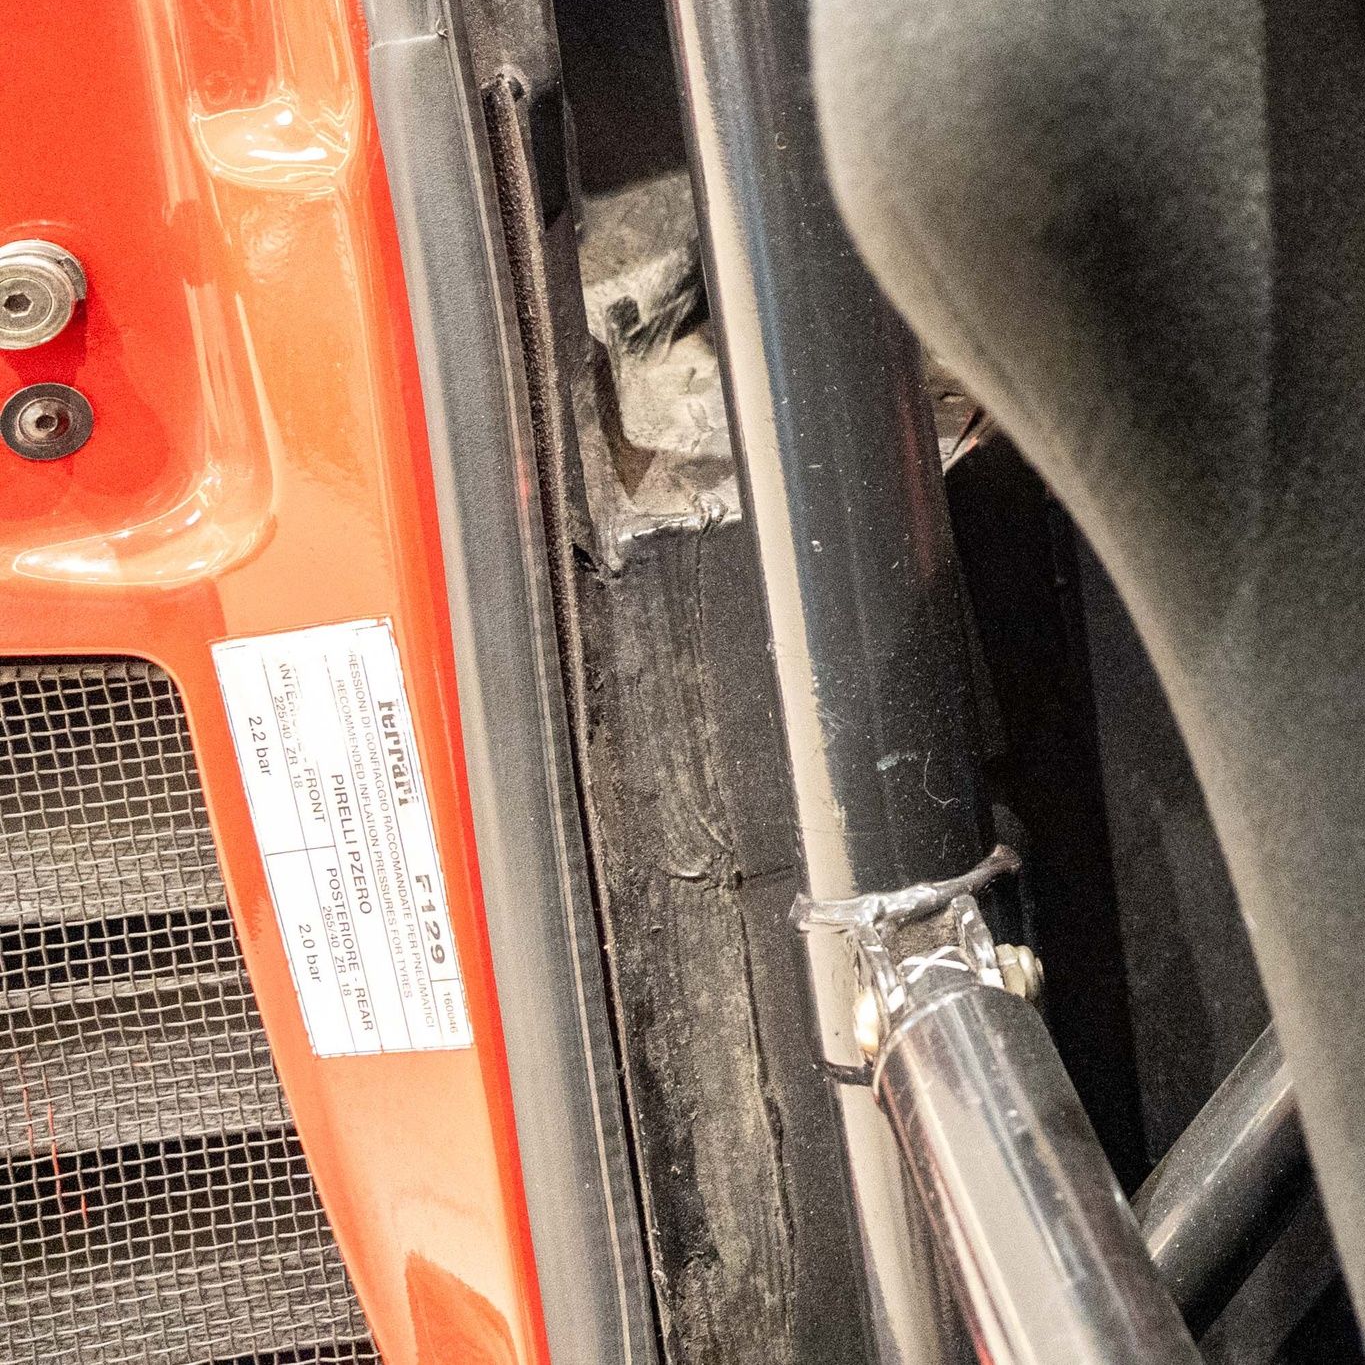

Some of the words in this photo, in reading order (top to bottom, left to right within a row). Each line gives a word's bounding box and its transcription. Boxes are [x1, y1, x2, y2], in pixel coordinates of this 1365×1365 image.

[348, 650, 367, 713] RESSIONI
[248, 716, 267, 742] 2.2
[273, 695, 292, 739] 225/40
[285, 747, 298, 766] ZR
[292, 774, 304, 789] 18
[360, 716, 371, 729] DI
[255, 747, 272, 776] bar
[303, 768, 326, 822] FRONT
[365, 732, 389, 812] GONFIAGGIO
[331, 774, 357, 844] PIRELLI
[347, 851, 372, 914] PZERO
[336, 679, 365, 780] RECOMMENDED
[359, 783, 380, 847] INFLATION
[373, 850, 397, 926] PRESSURES
[390, 929, 403, 955] FOR
[397, 959, 413, 999] TYRES
[383, 815, 412, 918] RACCOMANDATE
[298, 924, 316, 949] 2.0
[322, 905, 340, 948] 265/40
[334, 956, 347, 974] ZR
[341, 983, 352, 997] 18
[326, 868, 360, 971] POSTERIORE
[354, 987, 374, 1031] REAR
[406, 923, 418, 949] PER
[415, 874, 446, 964] F129
[306, 954, 322, 983] bar
[411, 952, 434, 1028] PNEUMATICI
